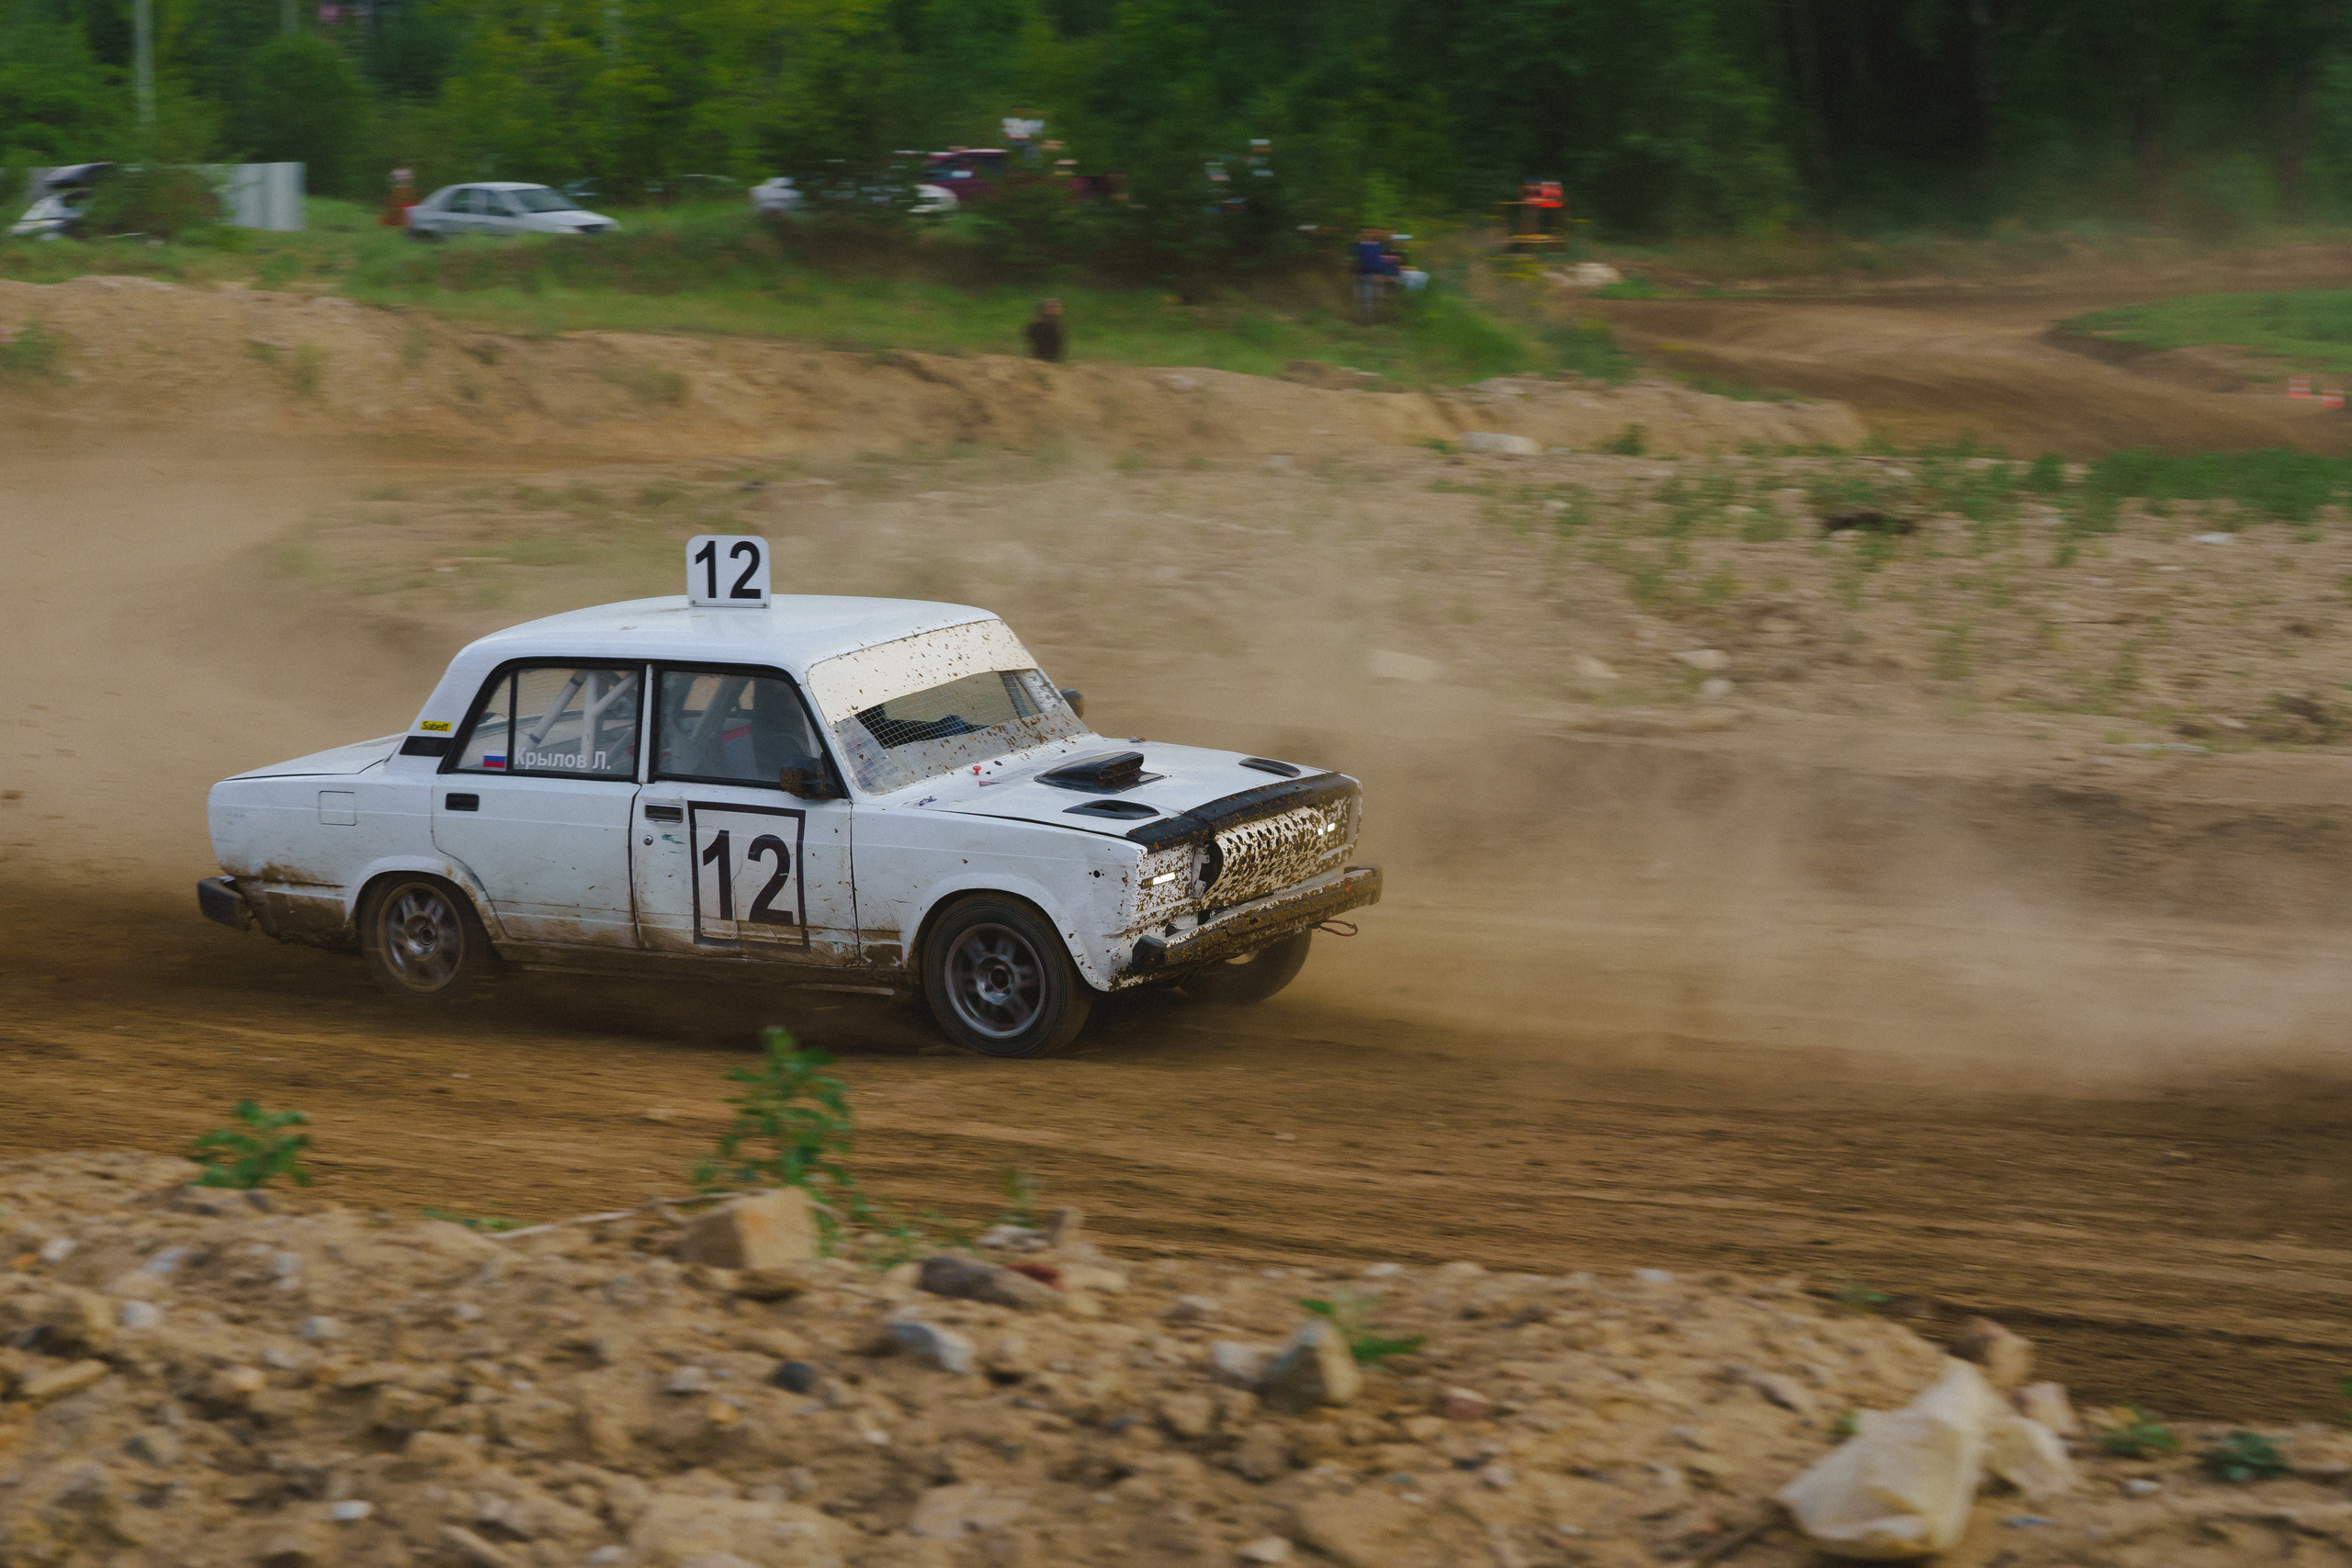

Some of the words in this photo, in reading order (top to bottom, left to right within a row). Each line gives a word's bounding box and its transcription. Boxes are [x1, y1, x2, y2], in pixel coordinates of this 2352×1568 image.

[695, 540, 761, 599] 12
[514, 748, 587, 769] Крылов
[592, 750, 611, 770] Л.
[702, 829, 793, 925] 12
